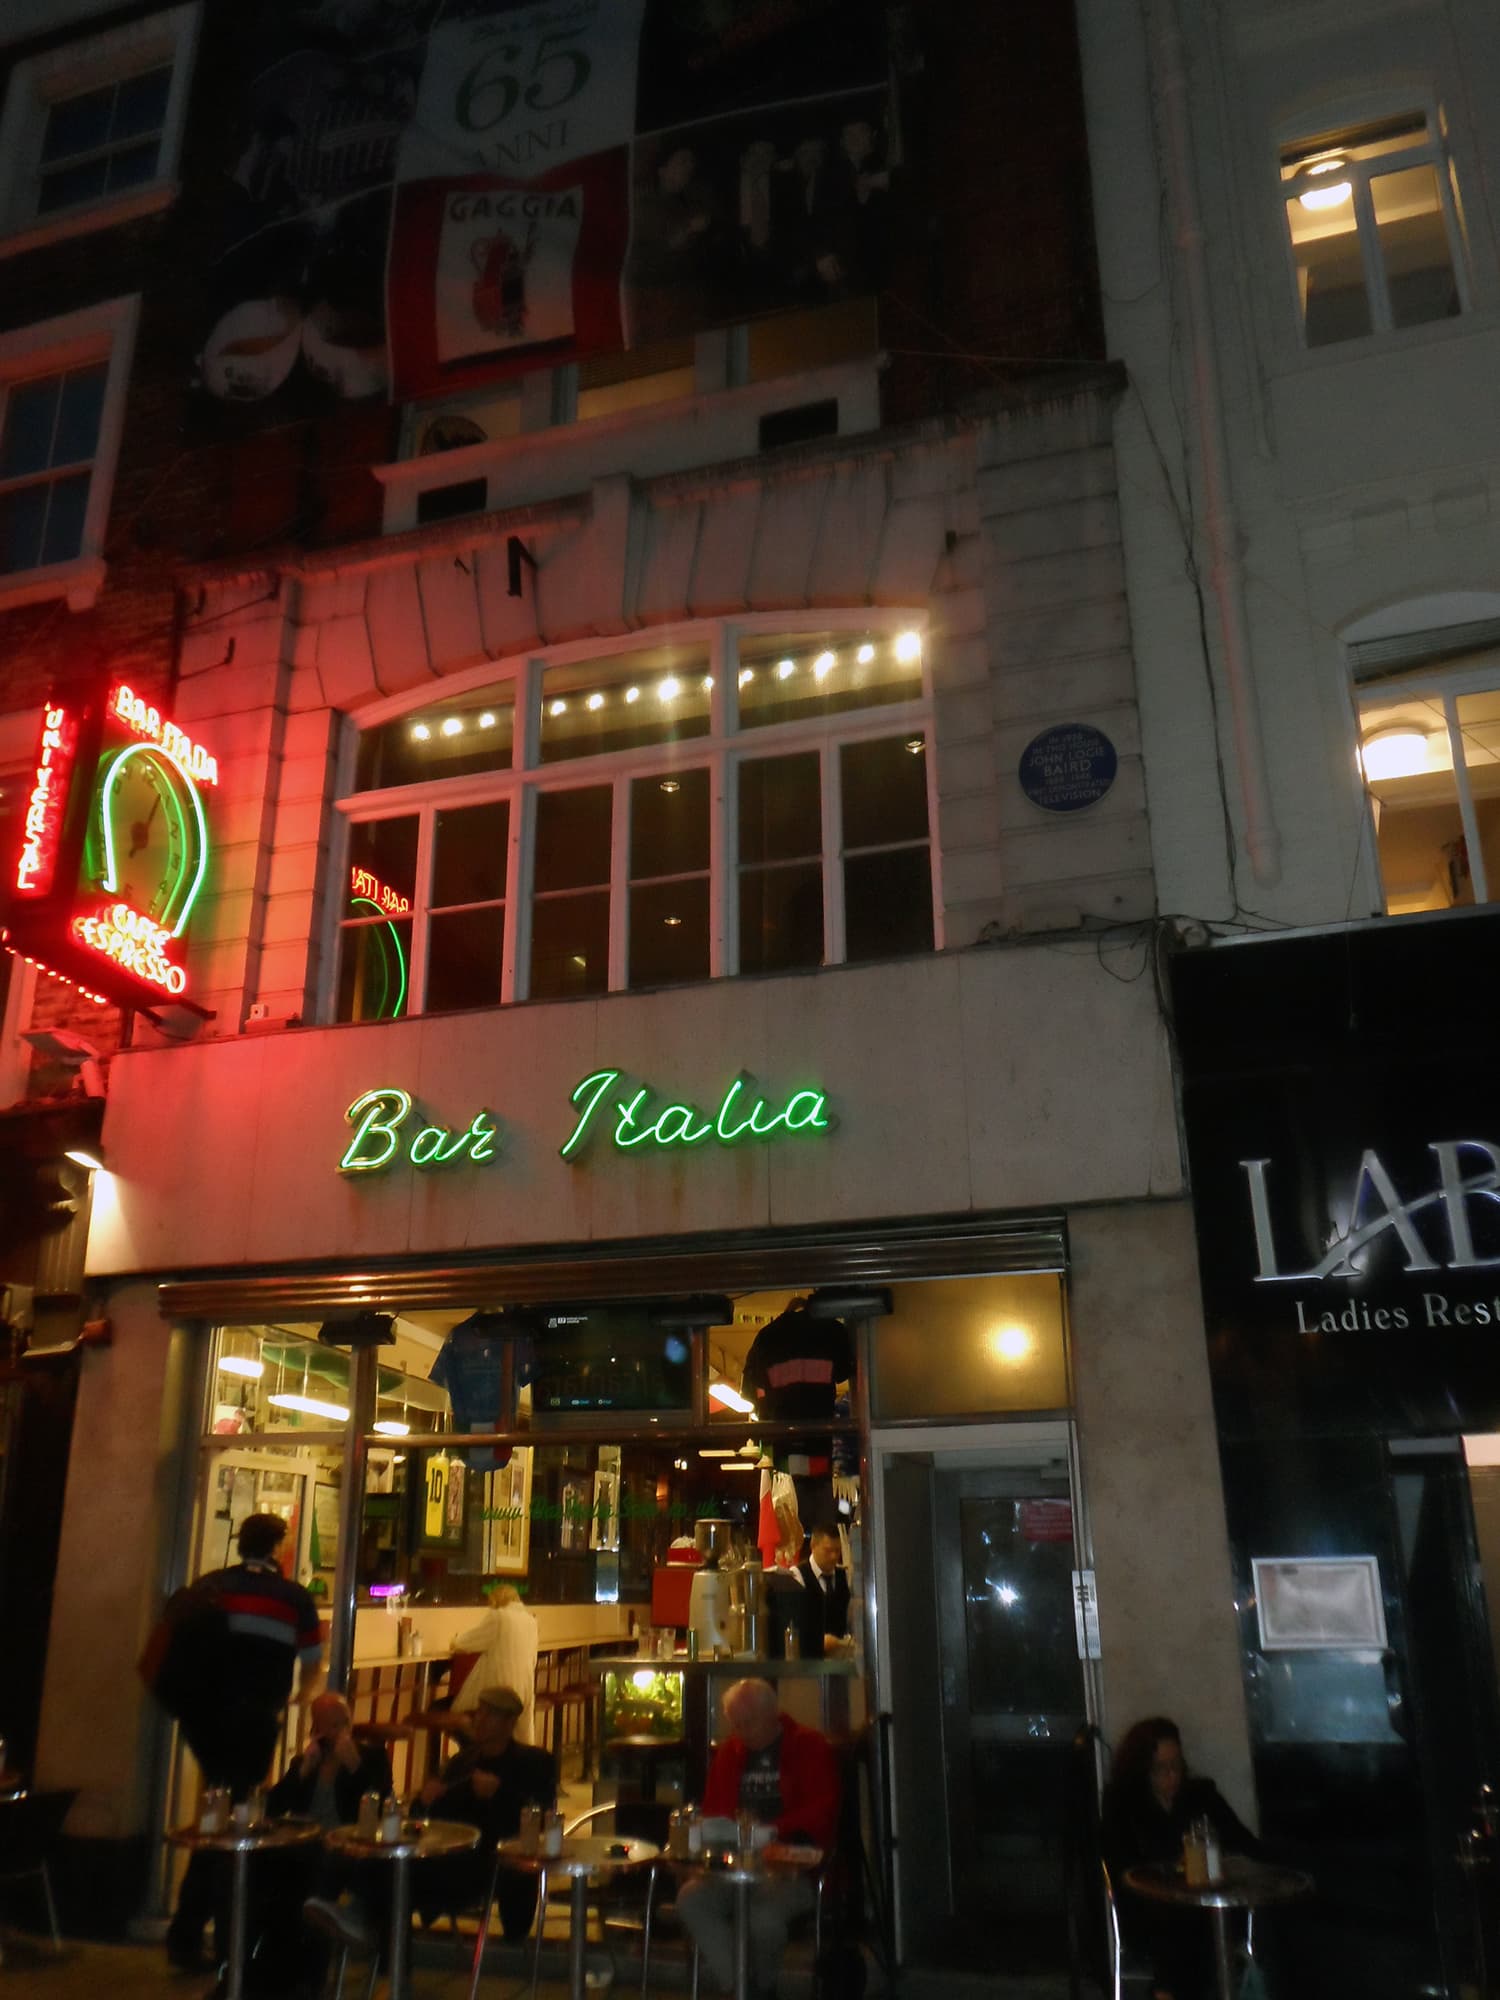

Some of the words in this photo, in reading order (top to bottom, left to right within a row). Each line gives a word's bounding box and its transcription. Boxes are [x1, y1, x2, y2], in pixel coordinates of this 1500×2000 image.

[456, 26, 591, 131] 65
[451, 195, 577, 222] GAGGIA
[115, 685, 160, 739] BAR
[17, 708, 64, 889] UNIVERSAL
[1043, 759, 1092, 777] BAIRD
[82, 917, 186, 994] ESPRESSO
[337, 1088, 496, 1173] Bar
[560, 1070, 829, 1157] Italia
[1239, 1138, 1500, 1281] LAB
[1296, 1298, 1410, 1334] Ladies
[429, 1467, 443, 1503] 10
